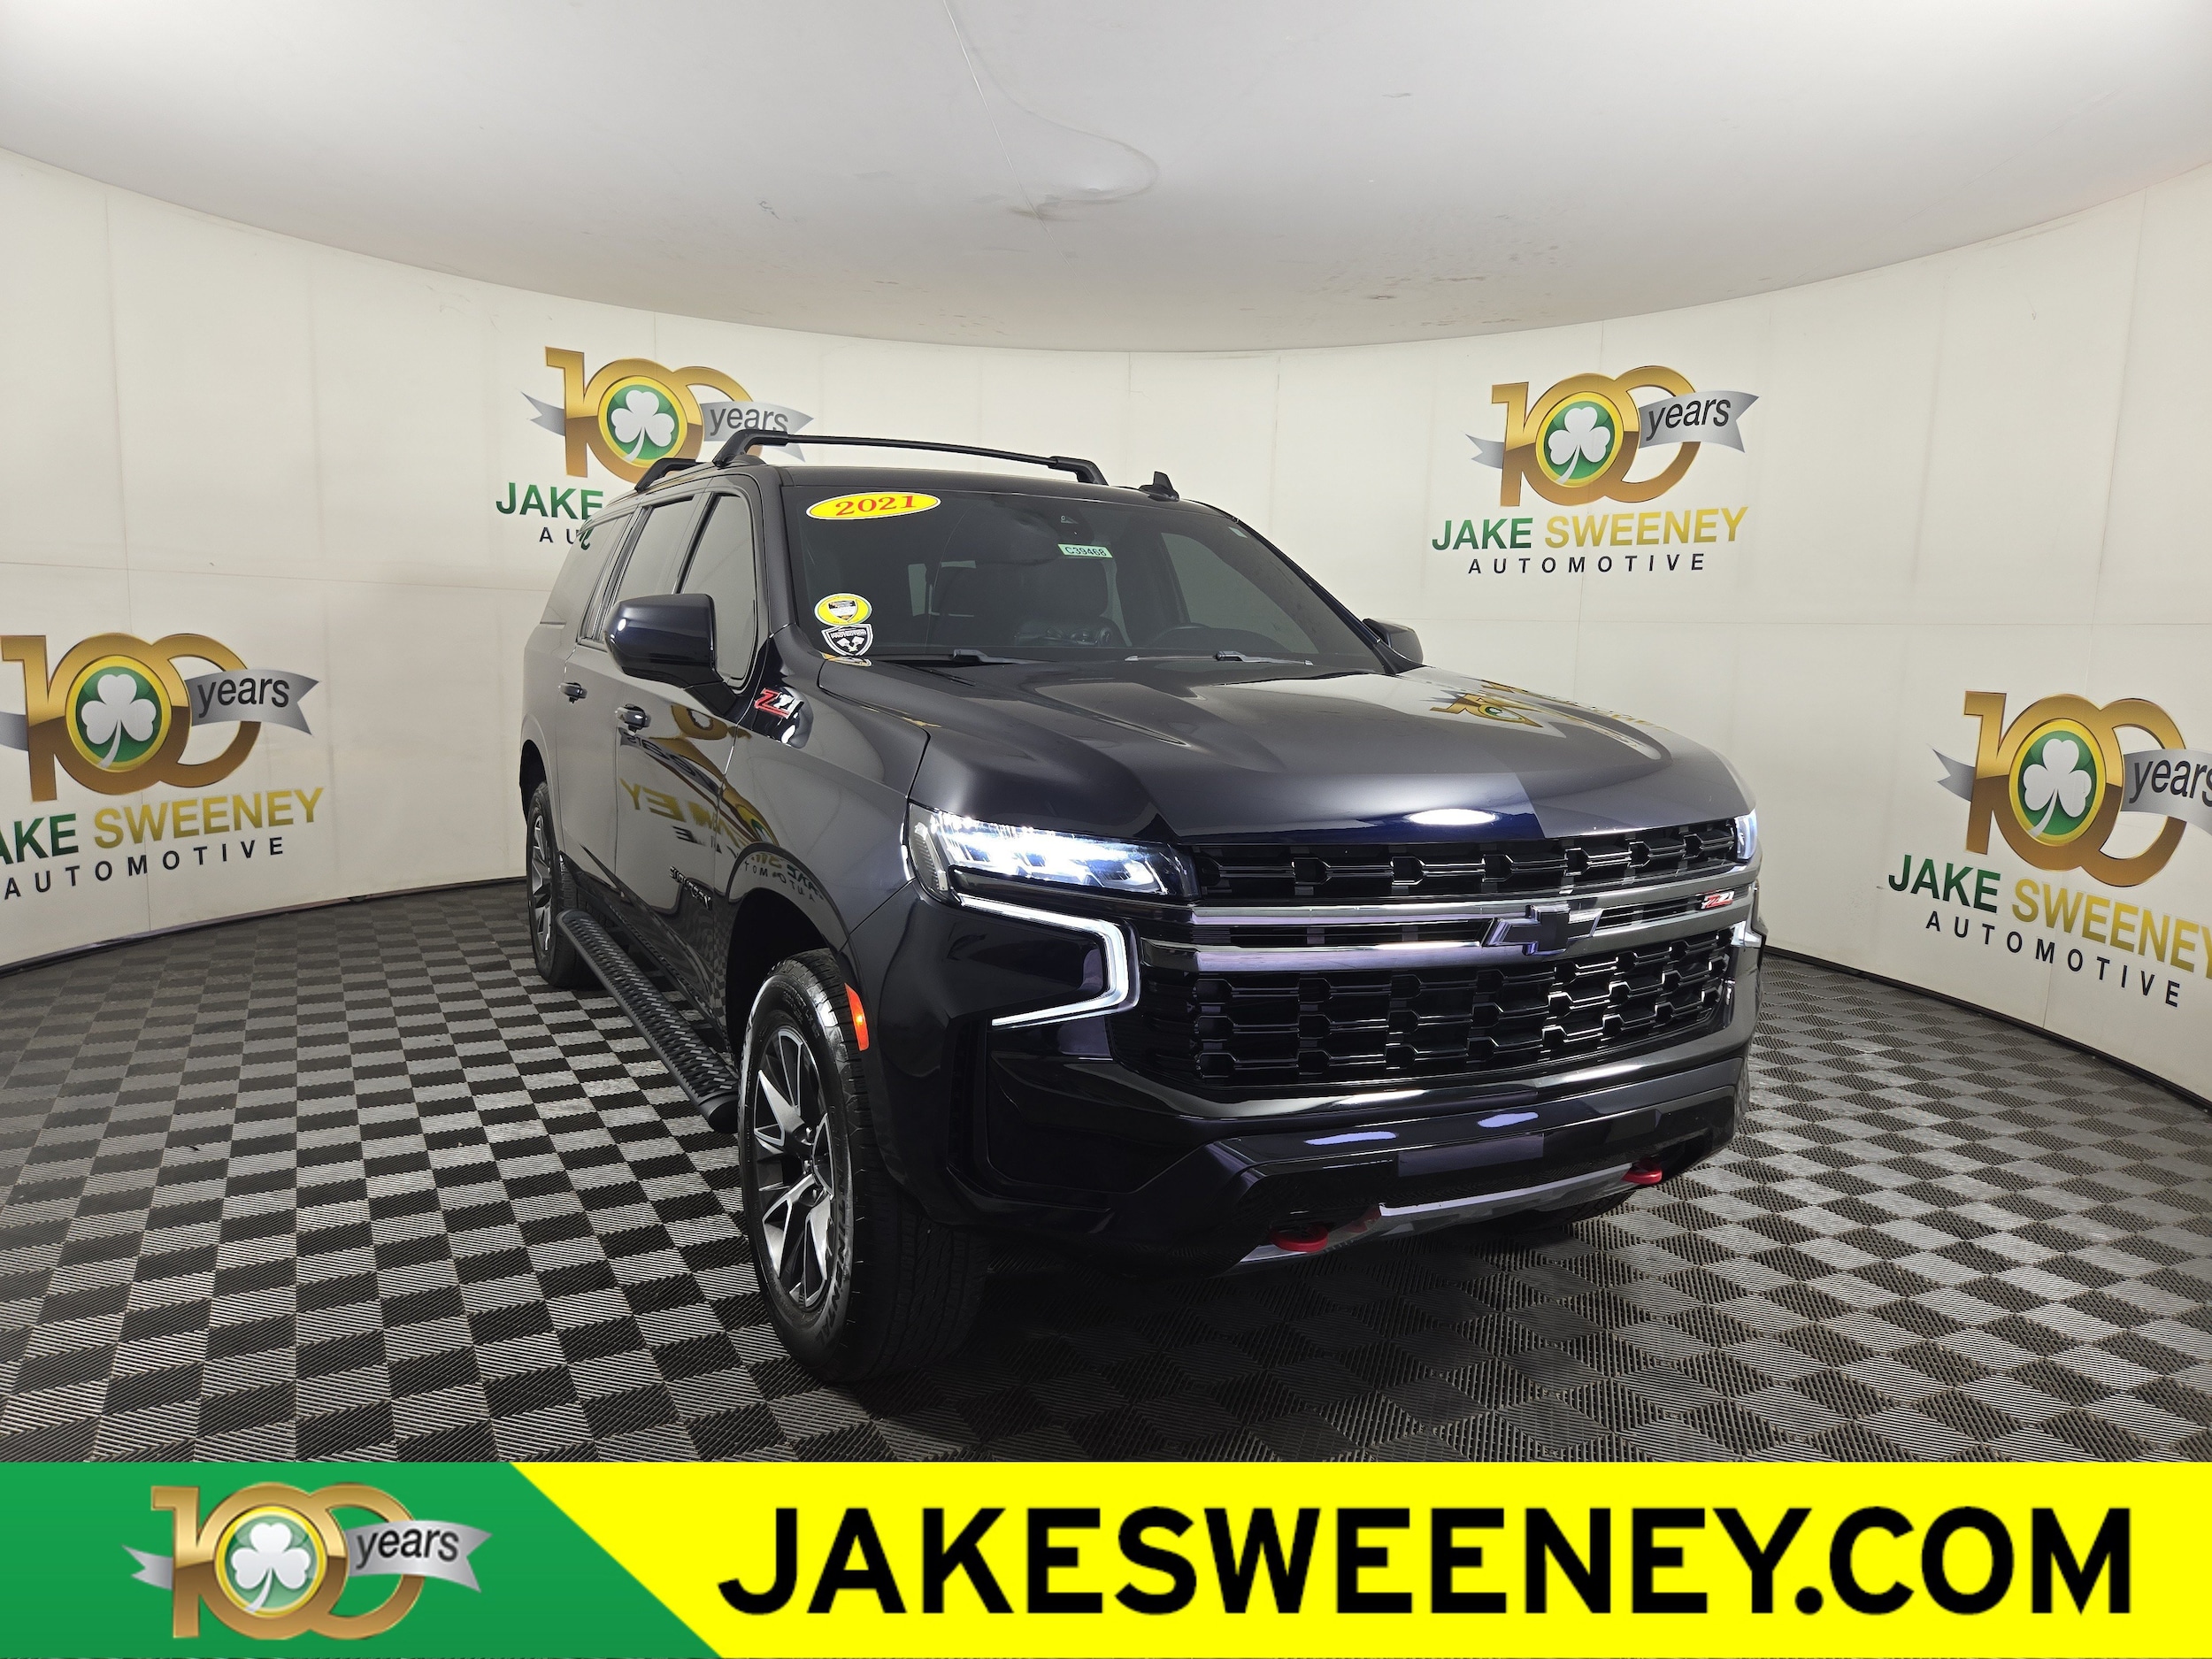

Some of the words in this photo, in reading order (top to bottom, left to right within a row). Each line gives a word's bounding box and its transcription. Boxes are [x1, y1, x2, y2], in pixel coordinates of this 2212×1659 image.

[710, 407, 789, 436] years
[1646, 399, 1732, 442] years
[495, 482, 603, 520] JAKE
[835, 495, 917, 516] 2021
[1432, 517, 1533, 551] JAKE
[1545, 506, 1748, 549] SWEENEY
[1064, 546, 1107, 557] C39468
[1468, 553, 1705, 574] AUTOMOTIVE
[197, 677, 290, 718] years
[94, 787, 325, 849] SWEENEY
[4, 837, 284, 901] AUTOMOTIVE
[1888, 855, 2001, 914] JAKE
[1925, 910, 2181, 1008] AUTOMOTIVE
